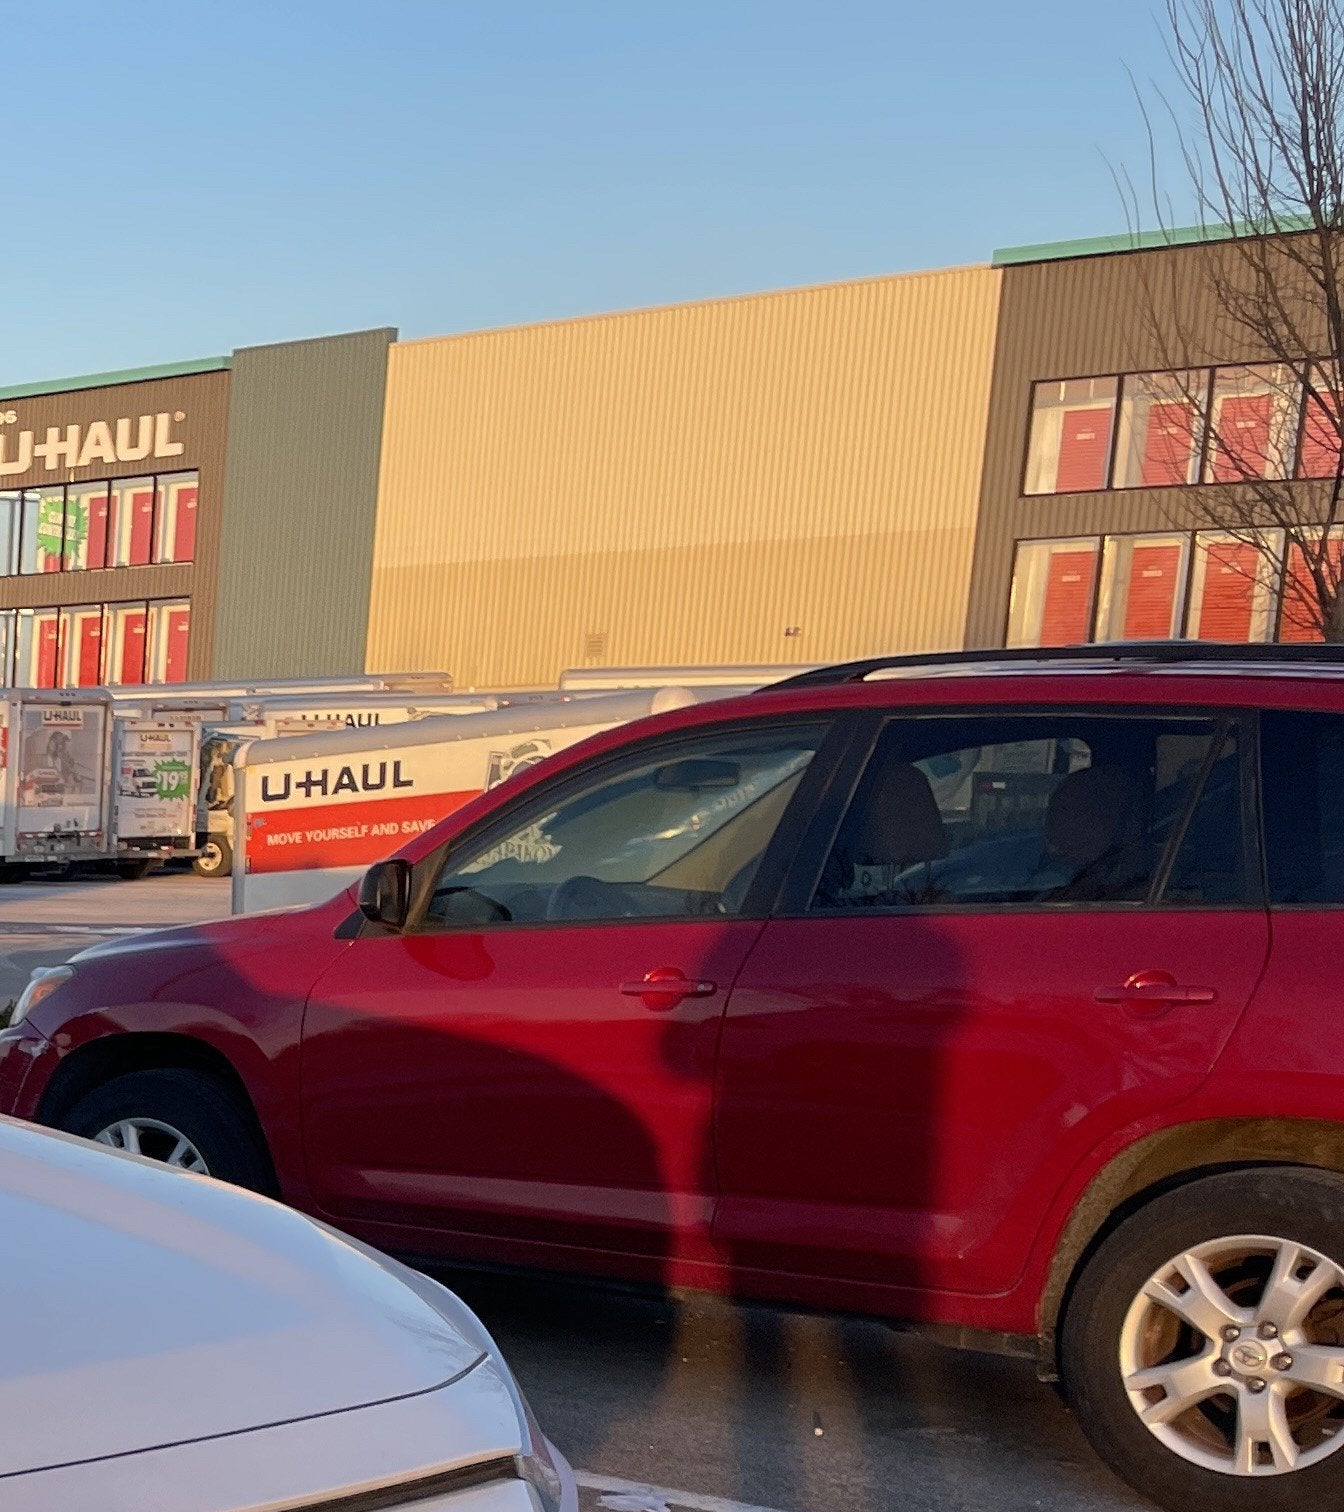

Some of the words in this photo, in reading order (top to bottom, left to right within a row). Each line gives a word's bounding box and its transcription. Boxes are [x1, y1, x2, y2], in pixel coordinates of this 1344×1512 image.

[262, 760, 414, 802] U-HAUL
[267, 831, 303, 846] MOVE
[306, 825, 368, 842] YOURSELF
[371, 821, 400, 837] AND
